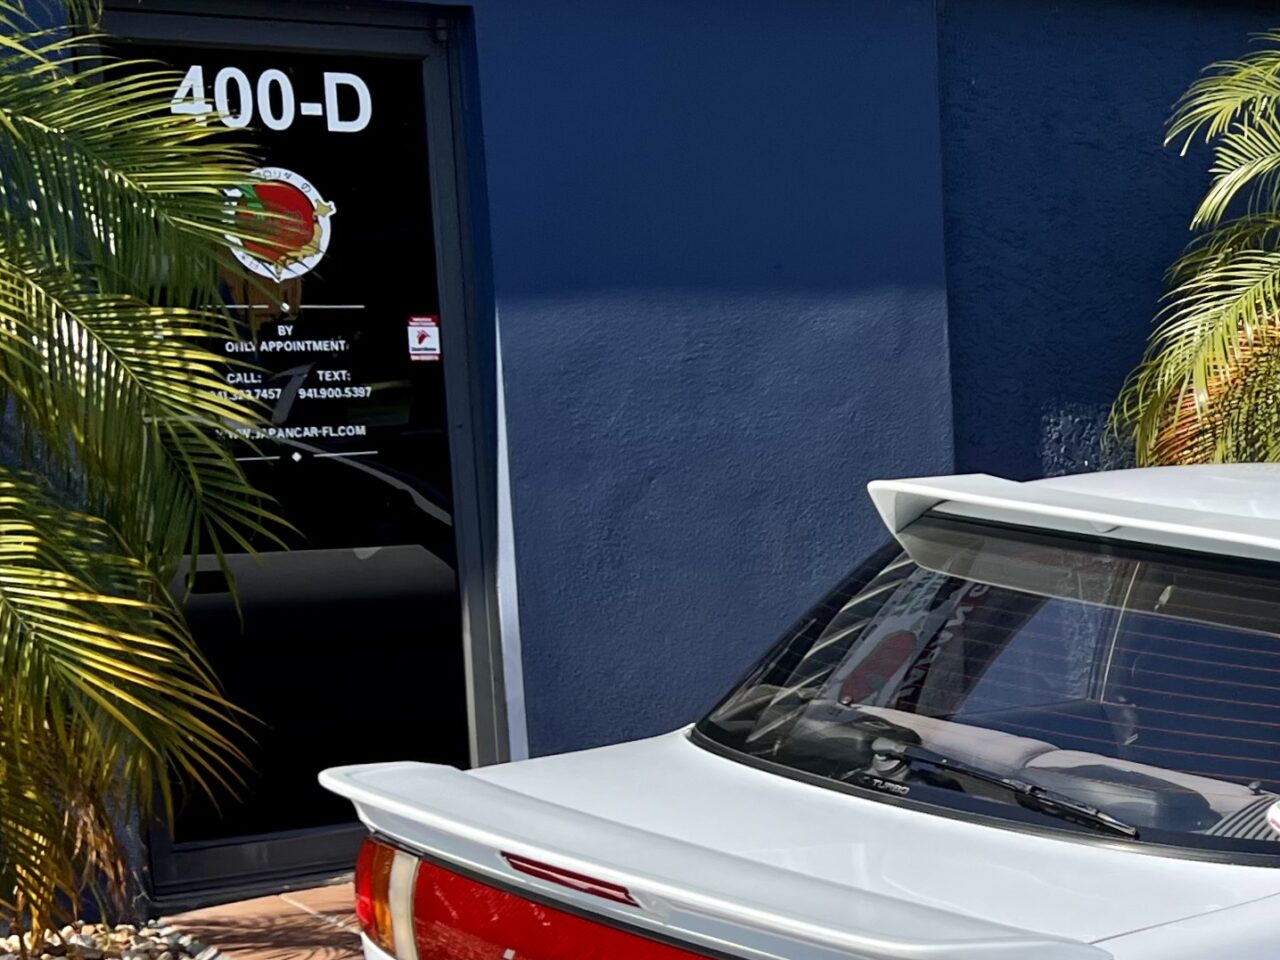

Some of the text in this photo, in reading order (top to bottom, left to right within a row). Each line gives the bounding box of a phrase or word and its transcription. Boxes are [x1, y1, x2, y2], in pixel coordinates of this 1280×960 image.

[171, 65, 373, 133] 400-D
[277, 325, 294, 337] BY
[260, 339, 346, 352] APPOINTMENT
[226, 373, 262, 384] CALL:
[316, 370, 352, 382] TEXT:
[298, 386, 372, 399] 941.900.5397
[872, 778, 911, 795] TURBO
